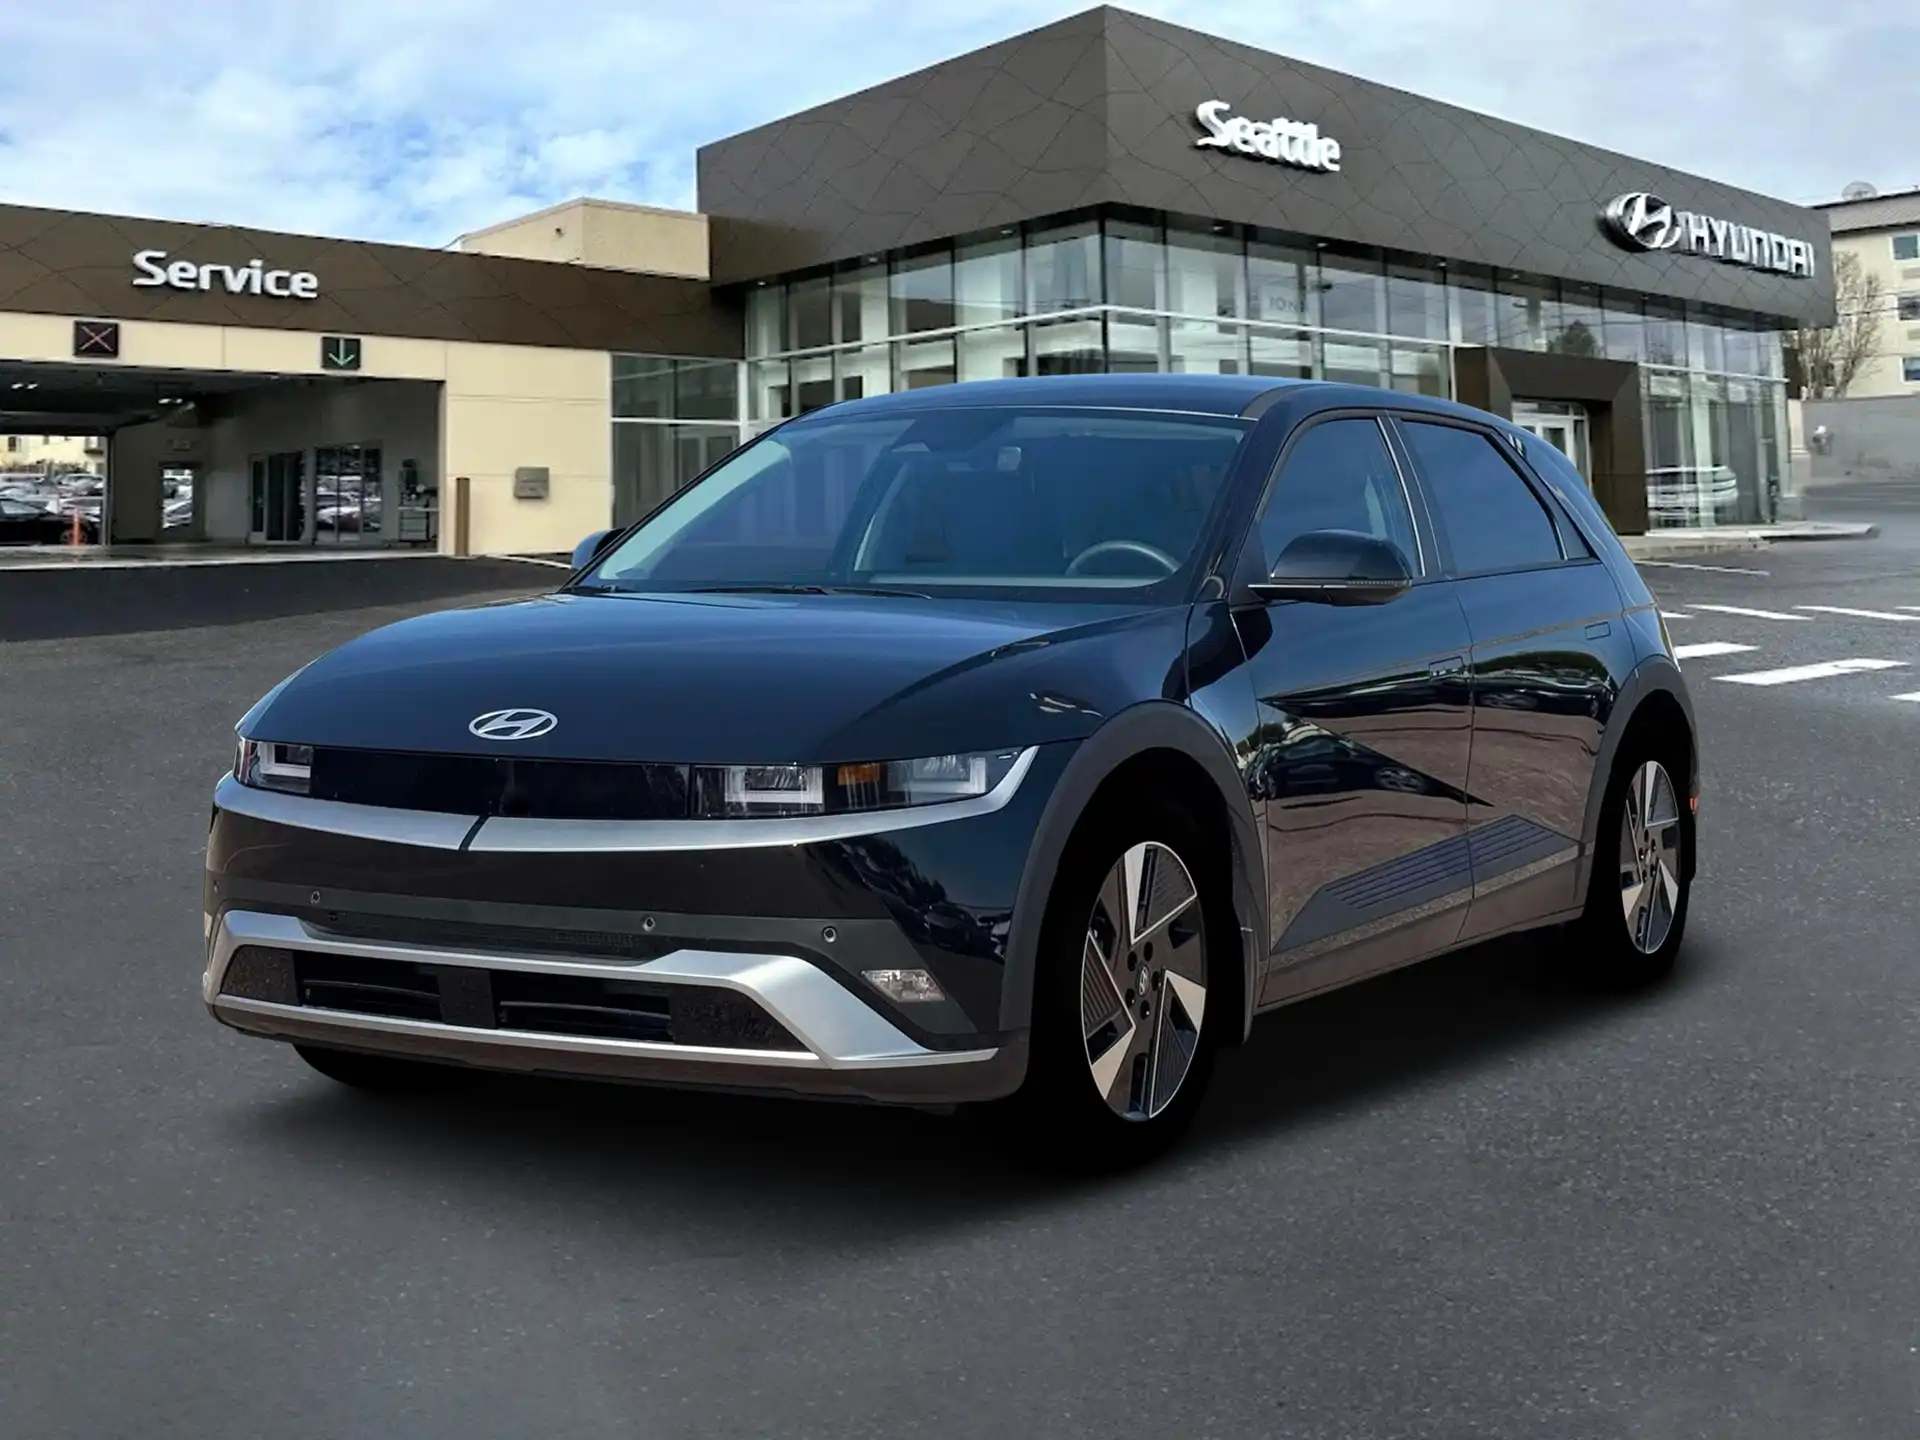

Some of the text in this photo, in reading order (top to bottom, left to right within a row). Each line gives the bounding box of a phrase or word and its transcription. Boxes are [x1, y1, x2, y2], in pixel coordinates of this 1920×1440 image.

[1196, 99, 1341, 172] Seattle
[132, 250, 318, 298] Service
[1680, 211, 1815, 277] HYUNDAI
